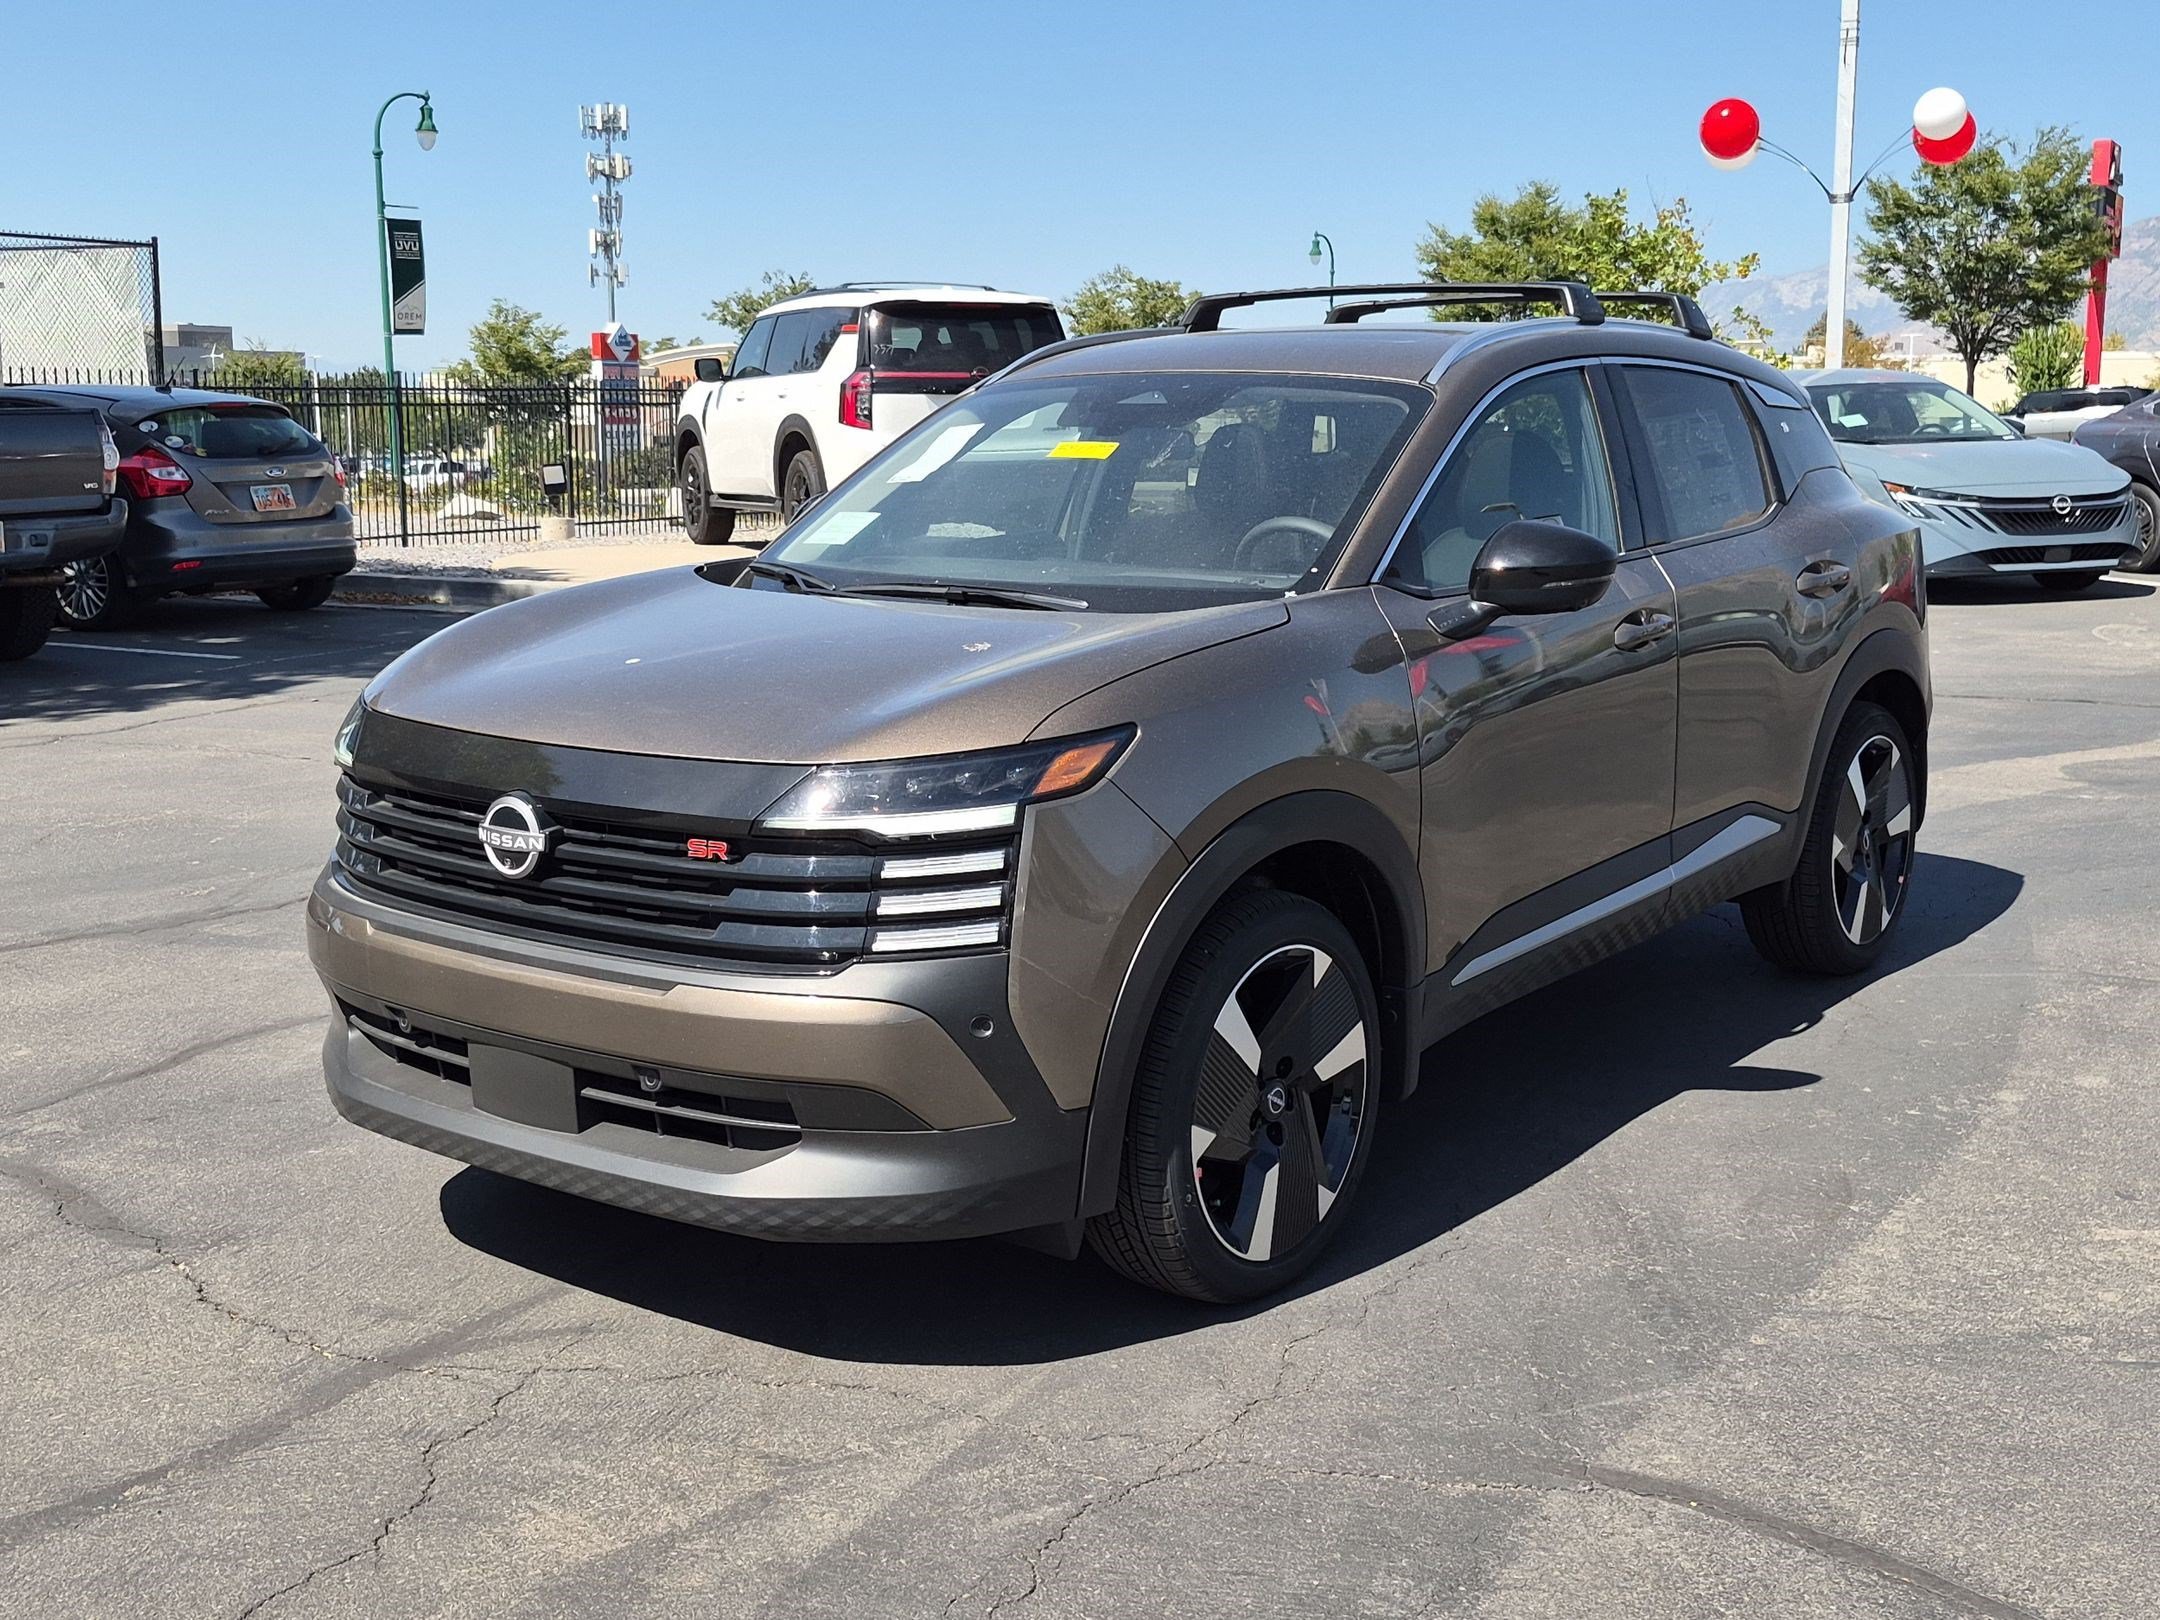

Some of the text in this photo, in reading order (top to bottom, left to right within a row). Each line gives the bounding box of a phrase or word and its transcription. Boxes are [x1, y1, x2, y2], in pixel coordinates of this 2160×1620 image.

[395, 240, 419, 250] UVU
[397, 312, 423, 321] OREM
[478, 827, 543, 850] NISSAN
[687, 838, 728, 861] SR
